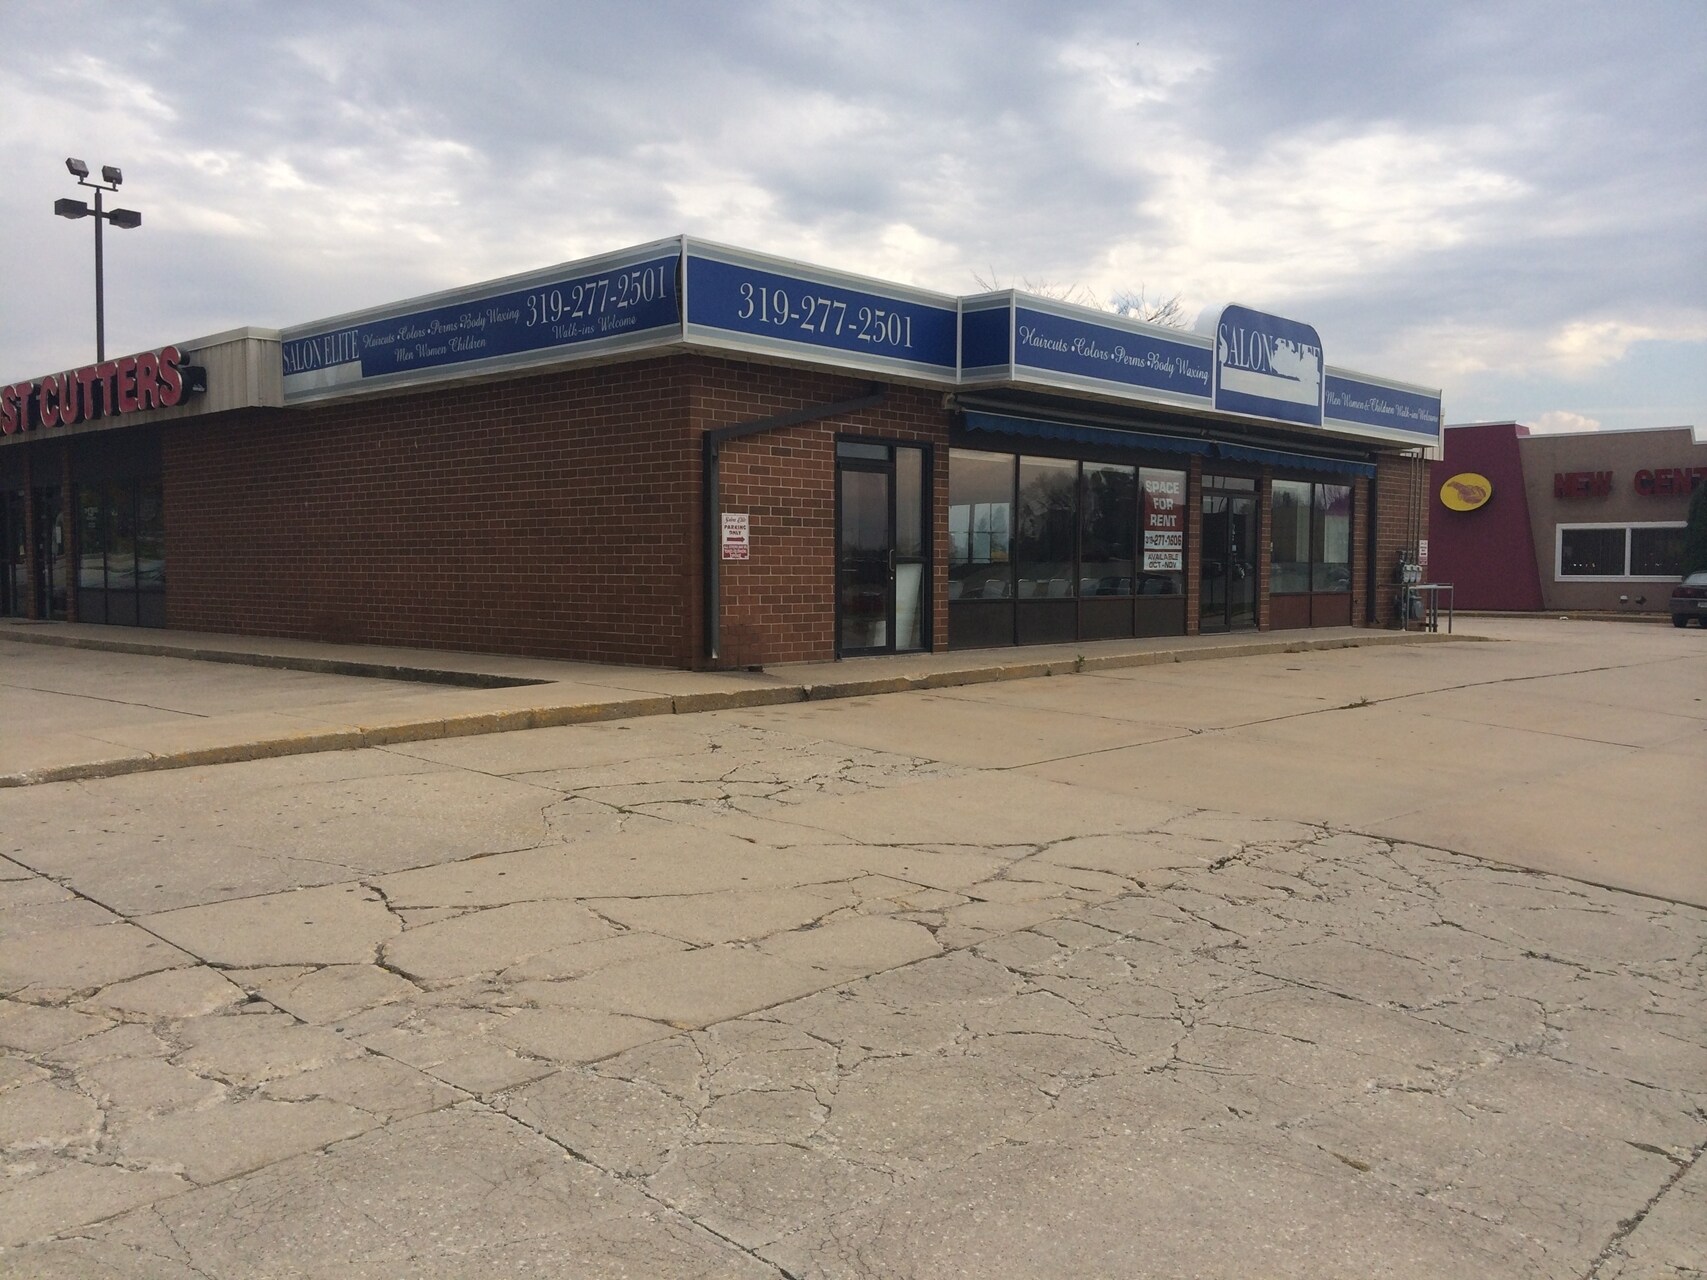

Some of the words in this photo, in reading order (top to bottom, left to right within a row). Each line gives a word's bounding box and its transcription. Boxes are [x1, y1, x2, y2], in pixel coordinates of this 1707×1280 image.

[526, 266, 667, 327] 319-277-2501
[363, 334, 395, 348] Haircuts
[399, 325, 425, 341] Colors
[430, 320, 458, 335] Perms
[462, 313, 486, 331] Body
[486, 308, 520, 324] Waxing
[552, 323, 595, 339] Walk-ins
[598, 314, 636, 332] Welcome
[738, 282, 913, 348] 319-277-2501
[283, 338, 322, 373] SALON
[324, 330, 360, 365] ELITE
[395, 347, 414, 362] Men
[416, 343, 447, 358] Women
[448, 335, 486, 353] Children
[1019, 325, 1069, 353] Haircuts
[1074, 337, 1109, 361] Colors
[1114, 346, 1146, 368] Perms
[1148, 351, 1175, 379] Body
[1175, 357, 1209, 386] Waxing
[1219, 323, 1273, 374] SALON
[0, 379, 34, 435] ST
[40, 345, 183, 429] CUTTERS
[1325, 390, 1341, 406] Men
[1341, 391, 1364, 411] Women
[1370, 398, 1395, 415] Children
[1395, 404, 1418, 420] Walk-ins
[1418, 408, 1439, 423] Welcome
[1145, 480, 1180, 494] SPACE
[1554, 471, 1613, 498] NEW
[1153, 497, 1174, 510] FOR
[1150, 514, 1177, 527] RENT
[1148, 553, 1179, 561] AVAILABLE
